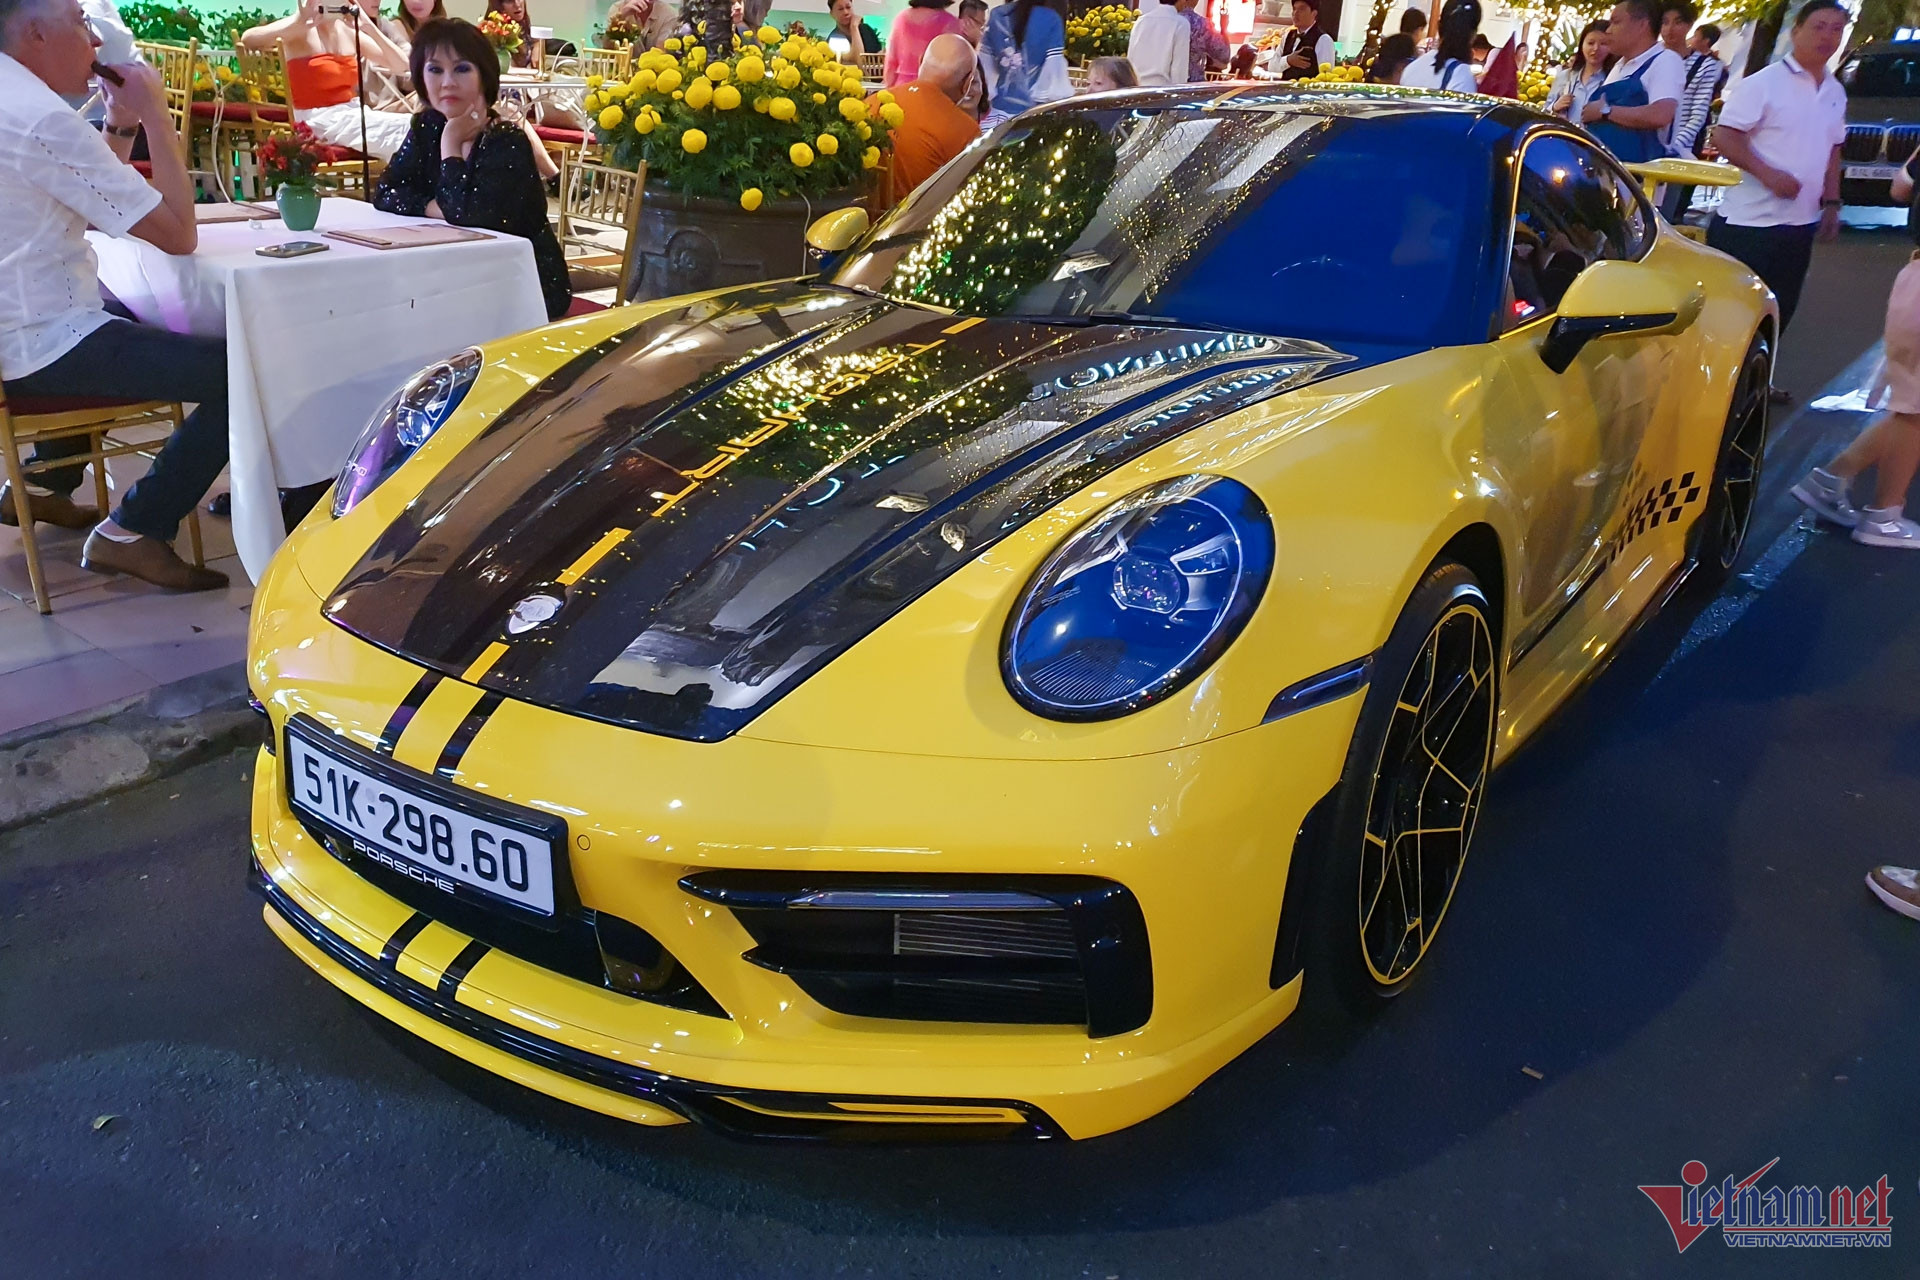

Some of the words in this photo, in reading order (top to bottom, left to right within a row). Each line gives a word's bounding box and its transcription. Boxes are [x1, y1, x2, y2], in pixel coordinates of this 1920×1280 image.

[651, 338, 947, 517] TECHART
[303, 752, 529, 892] 51K-298.60
[352, 839, 456, 894] PORSCHE
